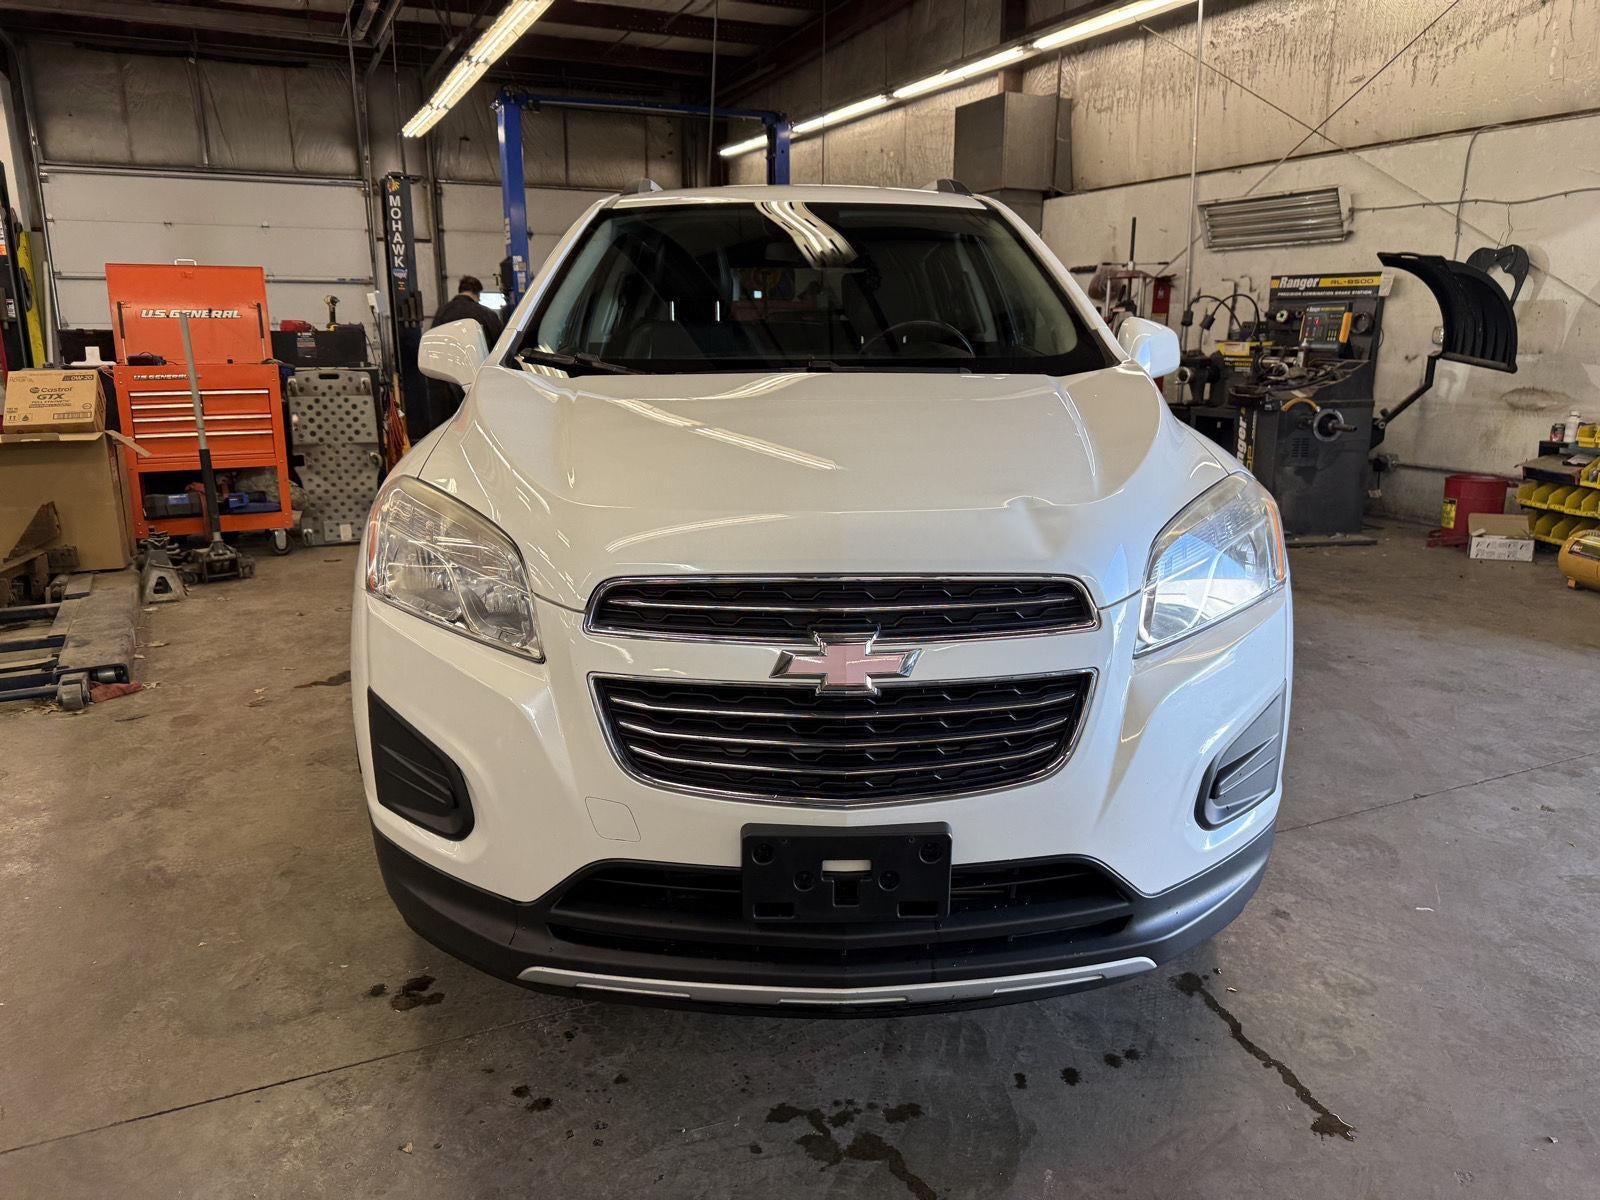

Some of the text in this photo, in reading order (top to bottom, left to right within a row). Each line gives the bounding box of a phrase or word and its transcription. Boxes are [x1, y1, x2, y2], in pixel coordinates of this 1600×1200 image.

[388, 195, 405, 268] MOHAWK
[1279, 276, 1320, 290] Ranger
[1236, 415, 1248, 466] nger
